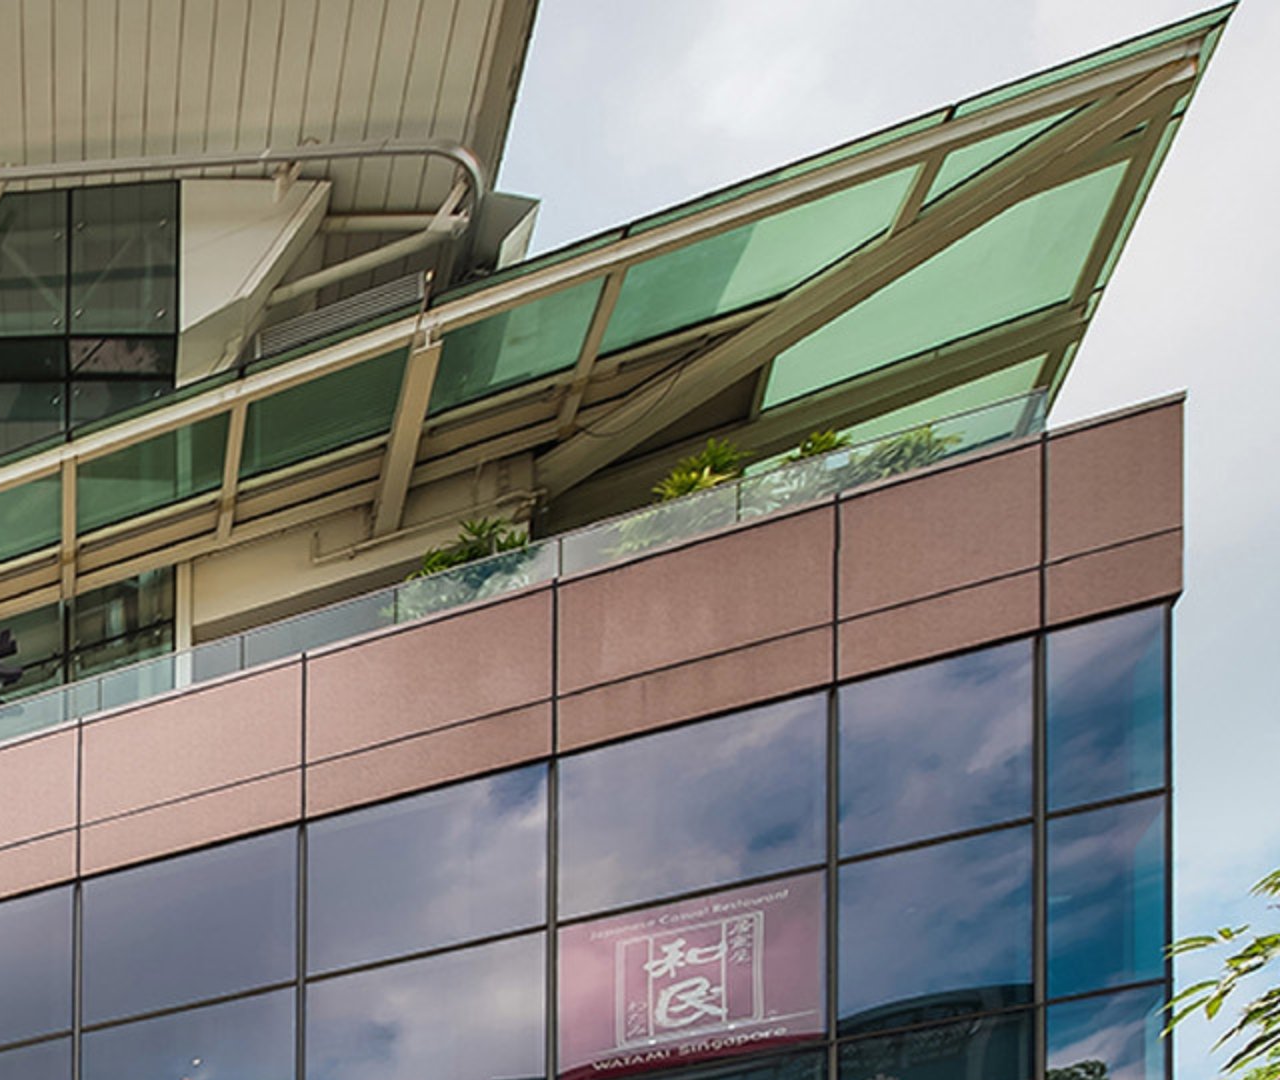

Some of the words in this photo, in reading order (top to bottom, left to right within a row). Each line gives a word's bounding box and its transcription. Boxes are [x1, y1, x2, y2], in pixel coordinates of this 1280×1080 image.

[644, 937, 729, 1028] 和民
[591, 1048, 670, 1071] WATAMI
[677, 1027, 788, 1056] Singapore
